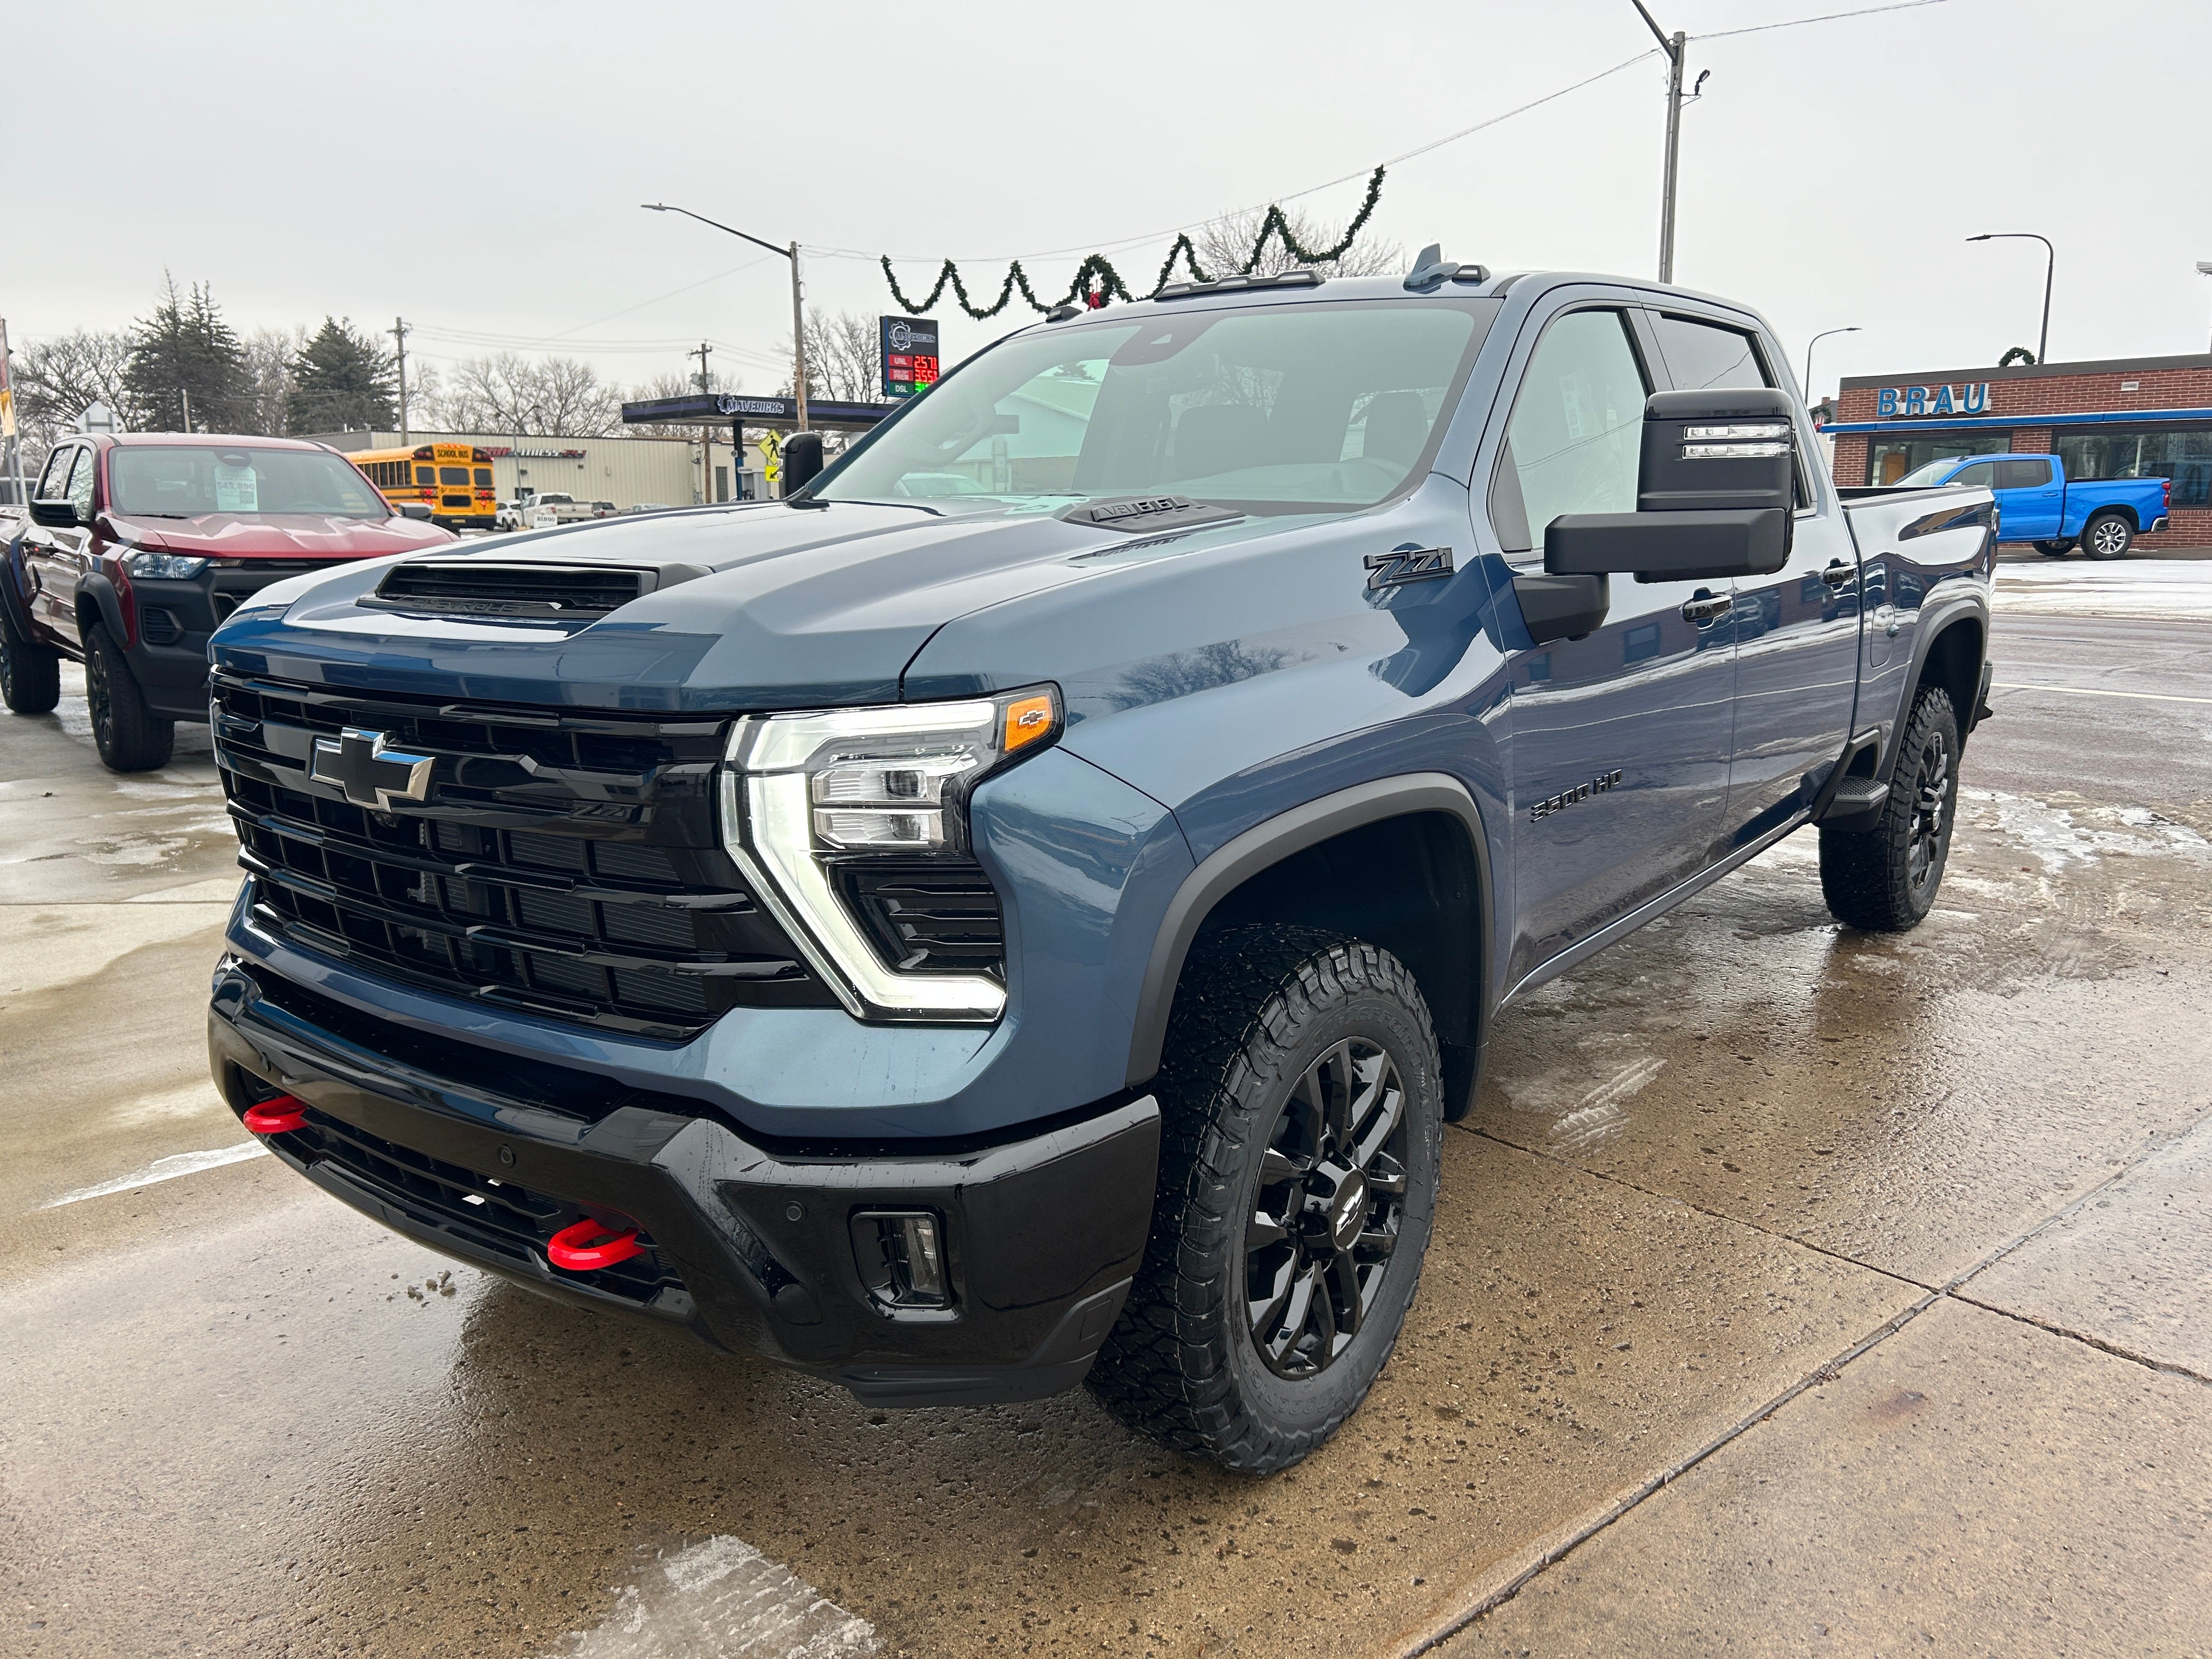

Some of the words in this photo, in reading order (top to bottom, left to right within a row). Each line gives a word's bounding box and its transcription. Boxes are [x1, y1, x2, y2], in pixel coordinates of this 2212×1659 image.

[894, 357, 908, 365] UNL
[895, 385, 909, 393] DSL
[1877, 382, 1989, 417] BRAU
[437, 449, 458, 458] SCHOOL
[458, 450, 469, 458] BUS
[1363, 546, 1454, 590] Z71
[412, 599, 534, 615] CHEVROLET
[1530, 783, 1589, 823] 3500
[1593, 768, 1622, 795] HD
